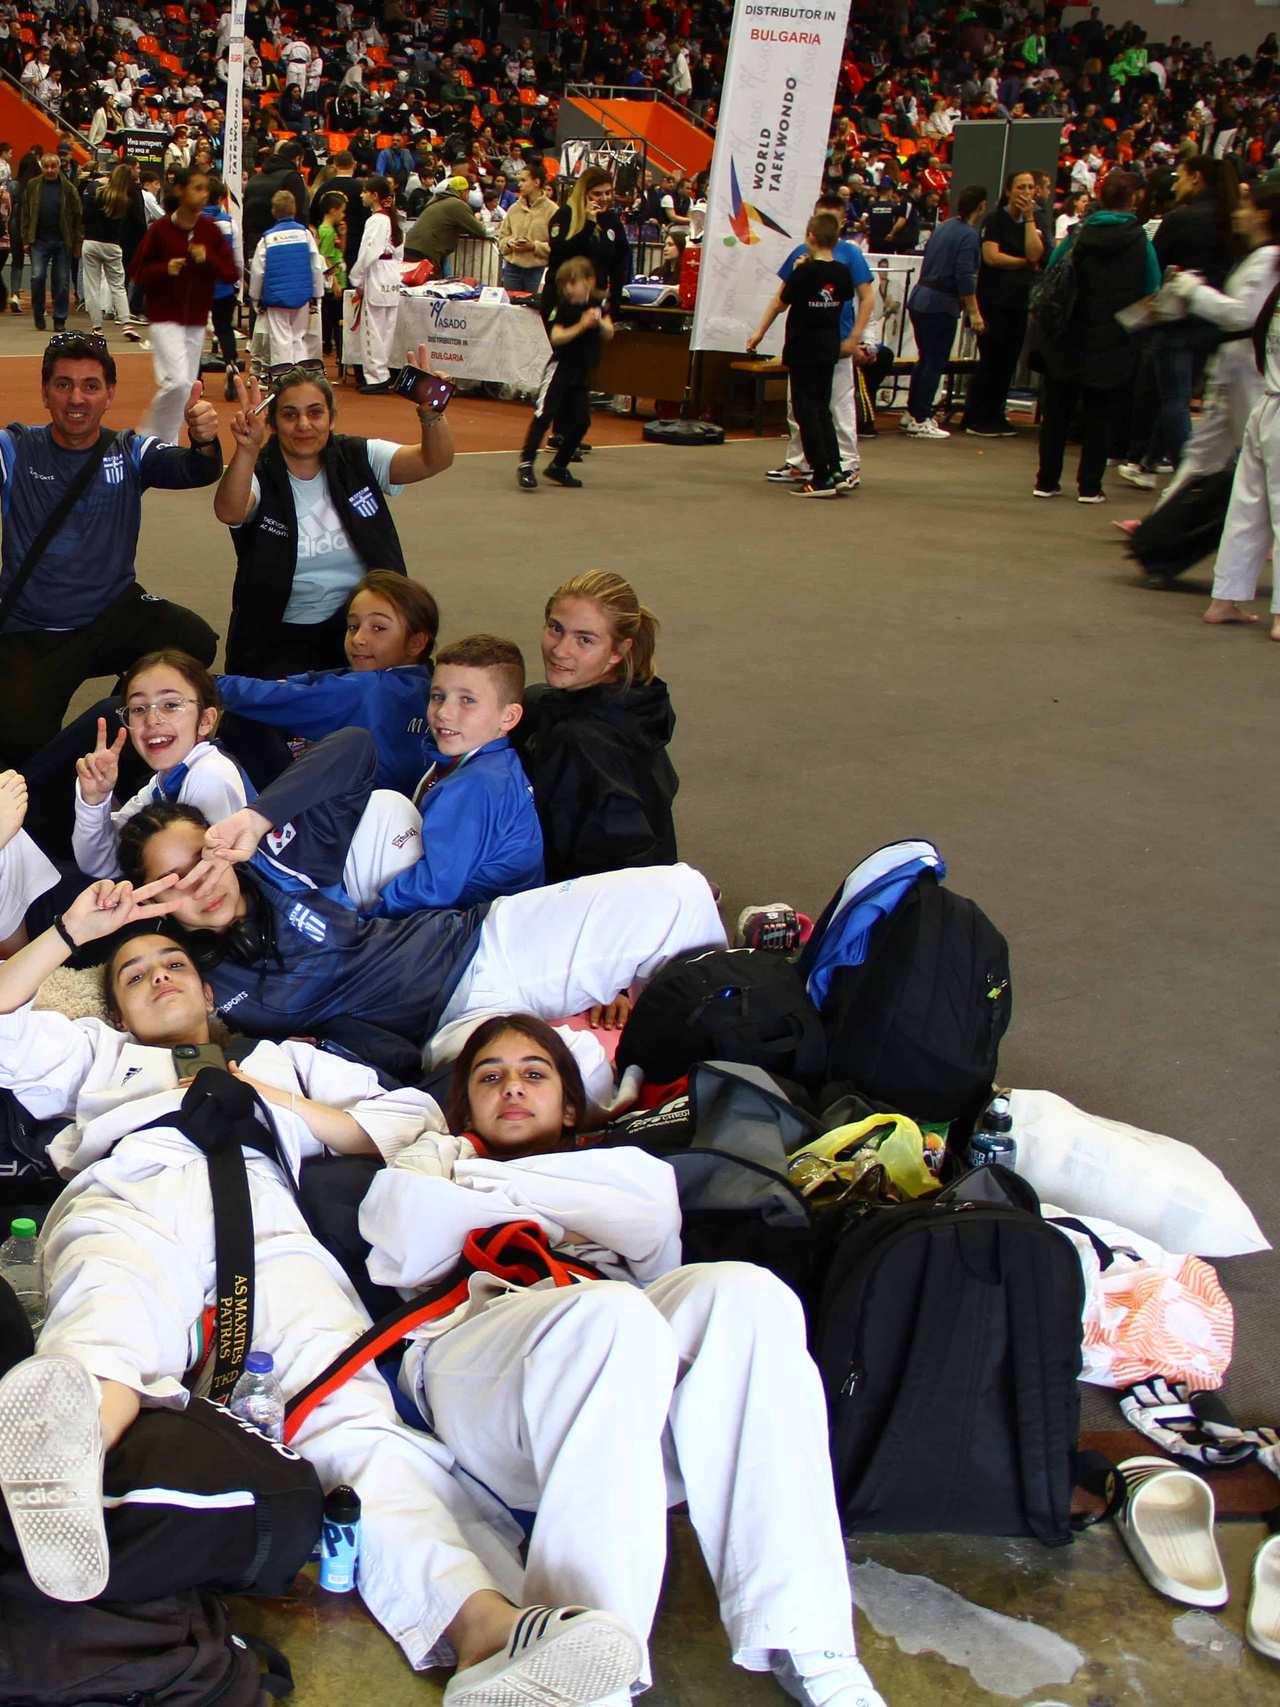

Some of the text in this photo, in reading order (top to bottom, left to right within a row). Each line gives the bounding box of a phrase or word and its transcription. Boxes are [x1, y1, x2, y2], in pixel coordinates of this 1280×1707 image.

[745, 5, 836, 21] DISTRIBUTOR IN
[750, 28, 821, 45] BULGARIA
[769, 77, 797, 192] TAEKWONDO
[753, 128, 771, 190] WORLD
[427, 336, 461, 346] DISTRIBUTOR
[430, 351, 464, 362] BULGARIA
[298, 531, 349, 558] dida
[220, 1296, 234, 1359] PATRAS
[231, 1274, 249, 1365] AS MAXITES
[214, 1369, 240, 1389] TKD
